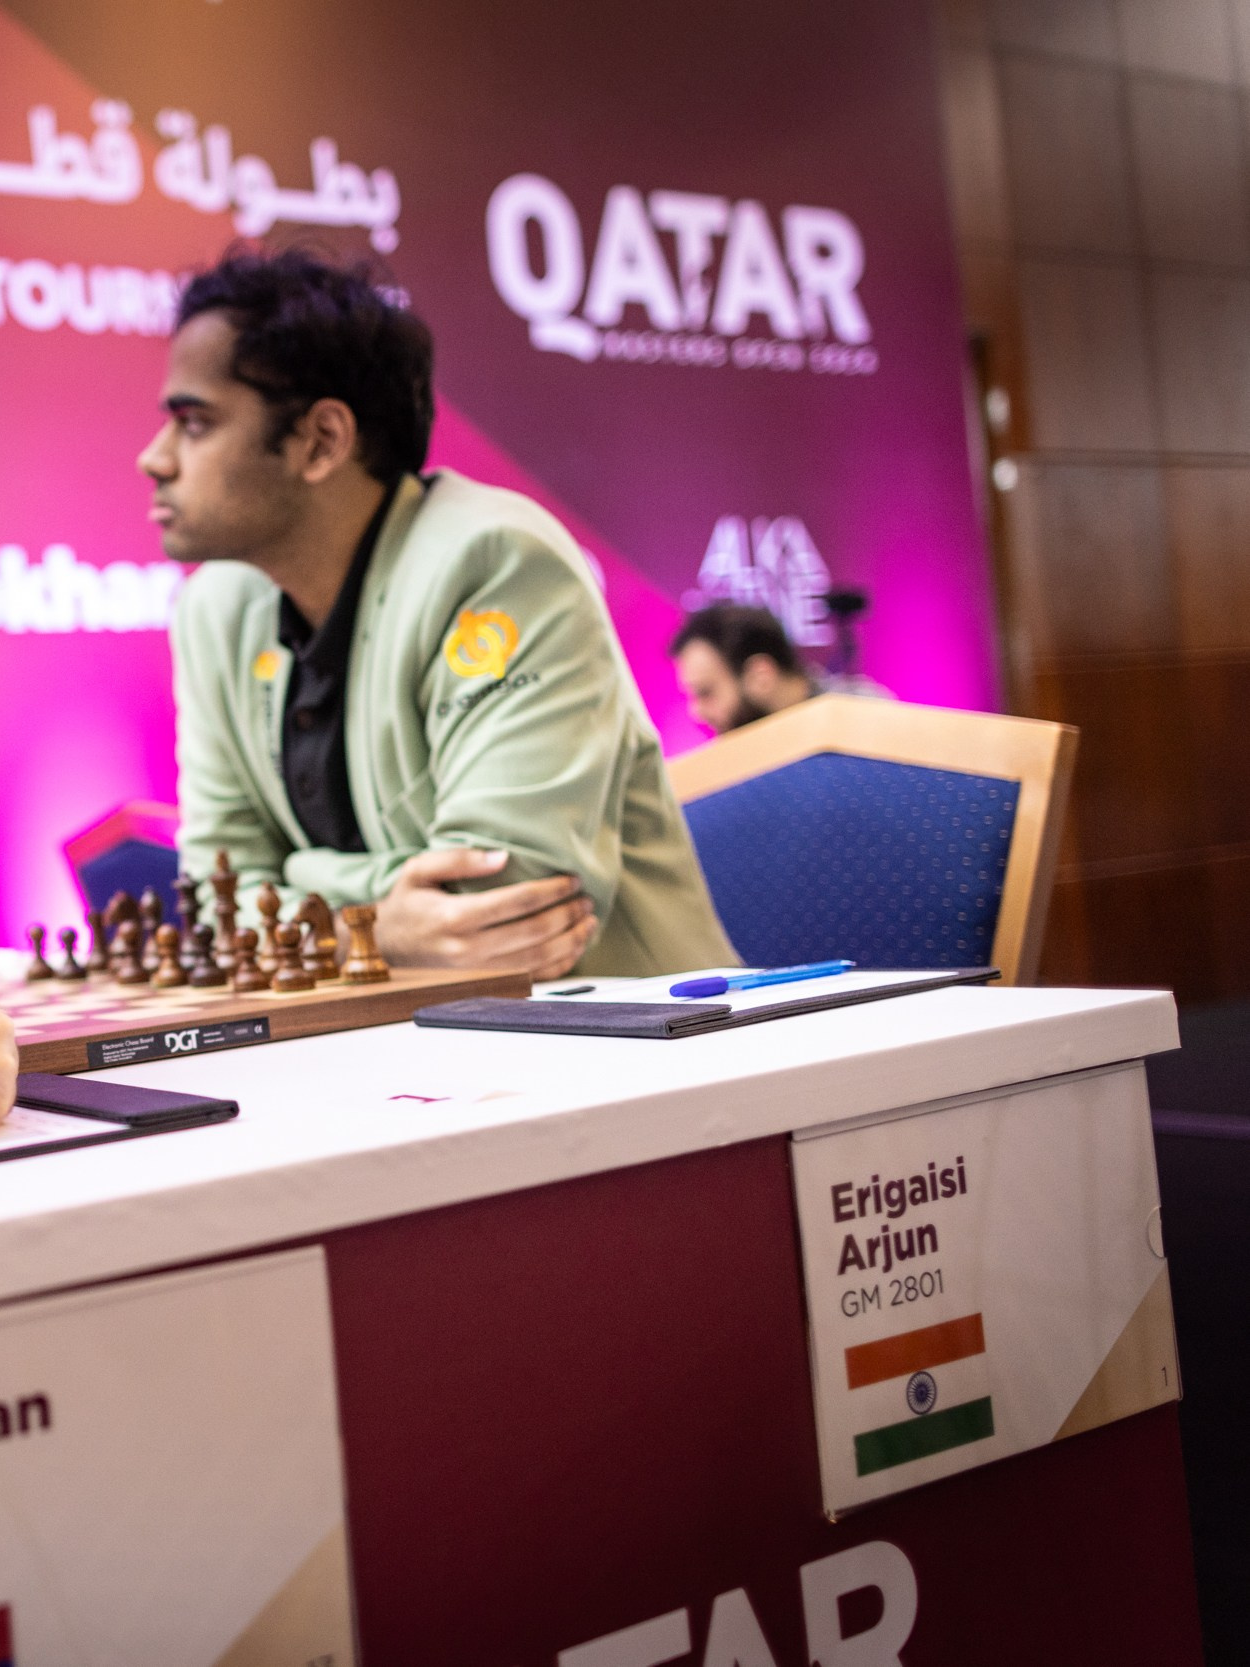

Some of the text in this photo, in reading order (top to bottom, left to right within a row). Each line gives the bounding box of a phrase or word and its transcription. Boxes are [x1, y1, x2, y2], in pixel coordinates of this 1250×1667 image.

[153, 109, 401, 252] بطولة
[486, 173, 872, 362] QATAR
[164, 1029, 200, 1053] DGT
[831, 1155, 967, 1223] Erigaisi
[837, 1224, 939, 1276] Arjun
[841, 1268, 944, 1318] GM 2801
[1160, 1366, 1168, 1387] 1
